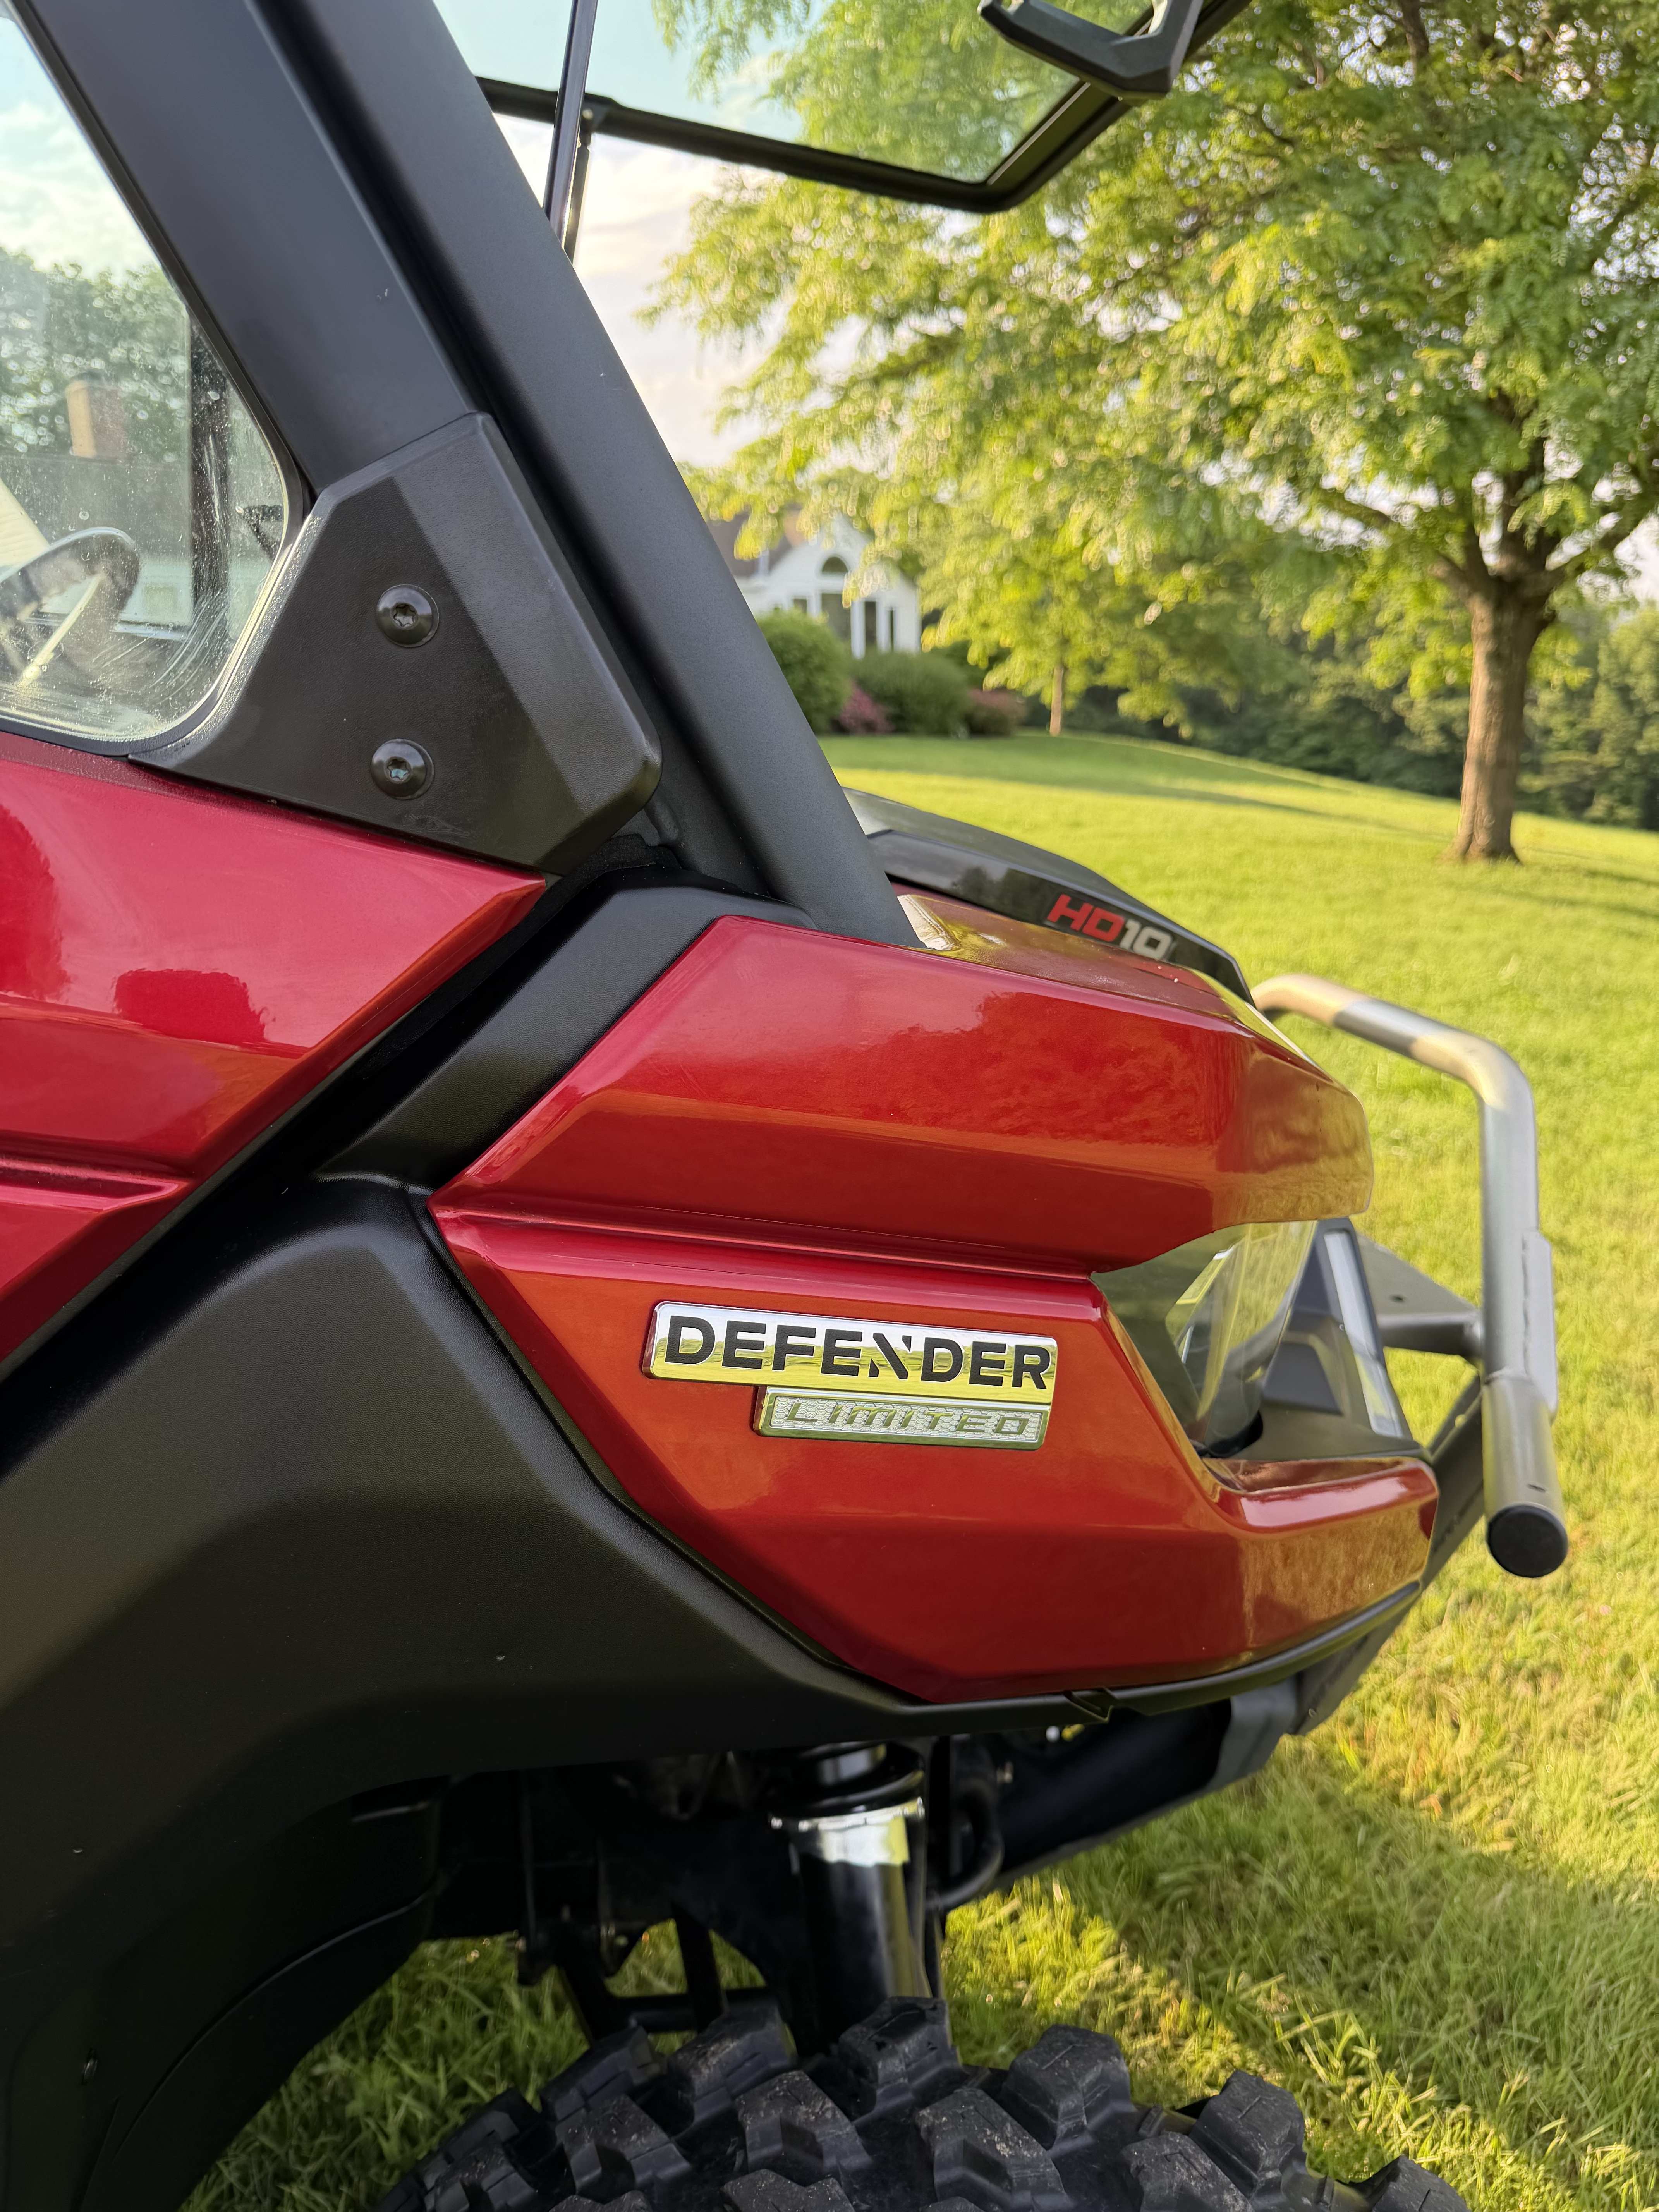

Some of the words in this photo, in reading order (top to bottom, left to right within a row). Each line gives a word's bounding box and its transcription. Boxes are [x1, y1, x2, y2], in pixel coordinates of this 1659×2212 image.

[1047, 894, 1173, 960] HD10
[665, 1316, 1051, 1389] DEFENDER
[787, 1402, 1029, 1435] LIMITED
